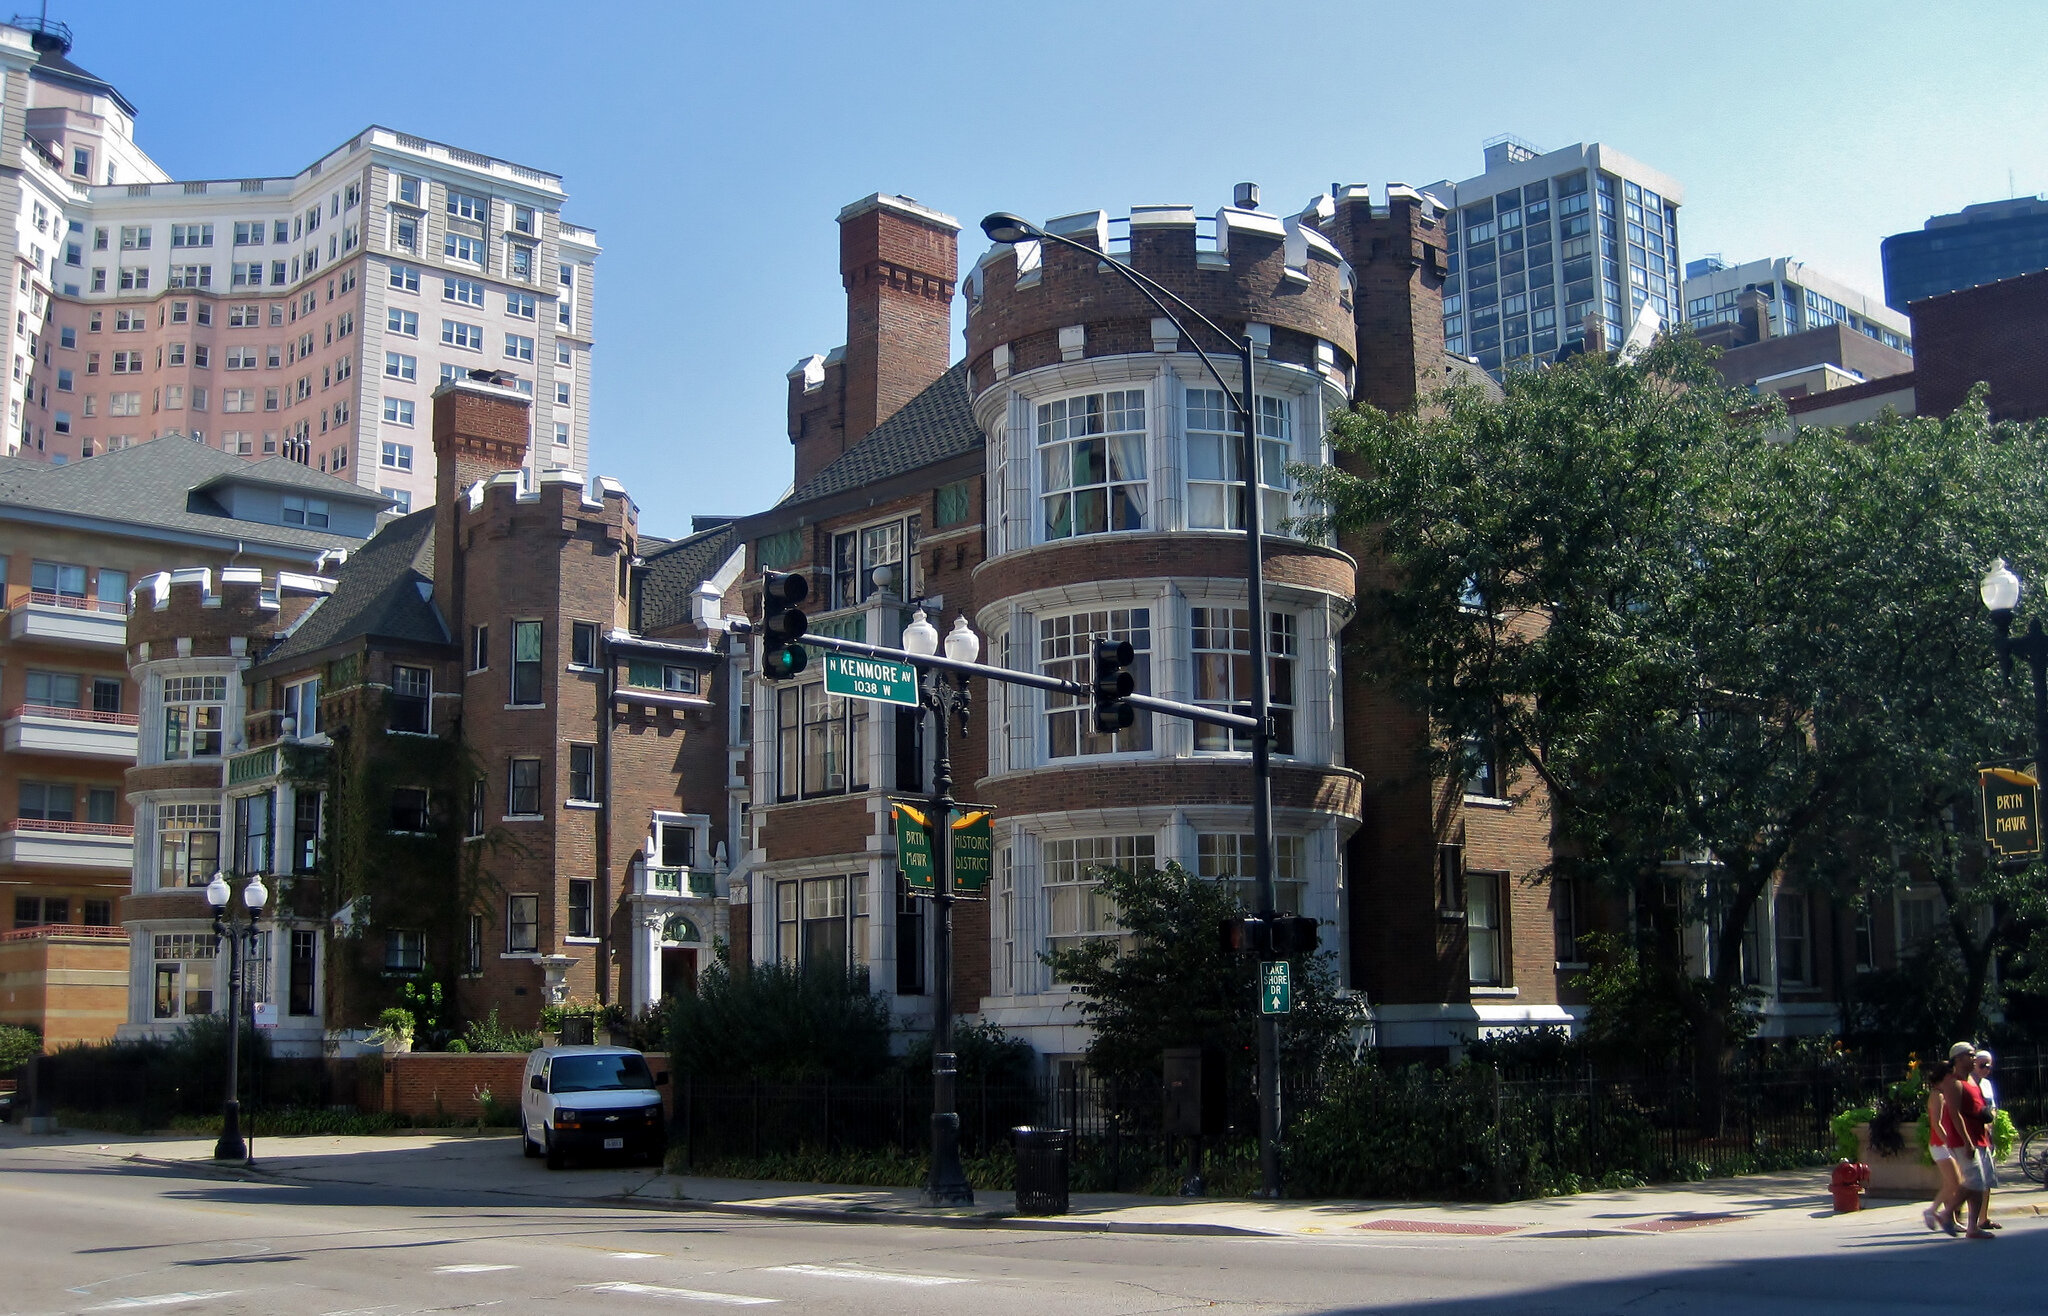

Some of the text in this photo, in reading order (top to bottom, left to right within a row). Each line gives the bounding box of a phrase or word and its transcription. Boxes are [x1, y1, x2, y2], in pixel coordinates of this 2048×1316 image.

[830, 658, 912, 683] N KENMORE AV
[854, 680, 891, 697] 1038 W
[1996, 793, 2023, 810] BRYN
[1996, 815, 2027, 833] MAWR
[906, 830, 925, 846] BRYN
[954, 834, 990, 851] HISTORIC
[906, 852, 927, 867] MAWR
[955, 856, 989, 871] DISTRICT
[1265, 965, 1285, 975] LAKE
[1263, 975, 1288, 985] SHORE
[1270, 985, 1282, 995] DR
